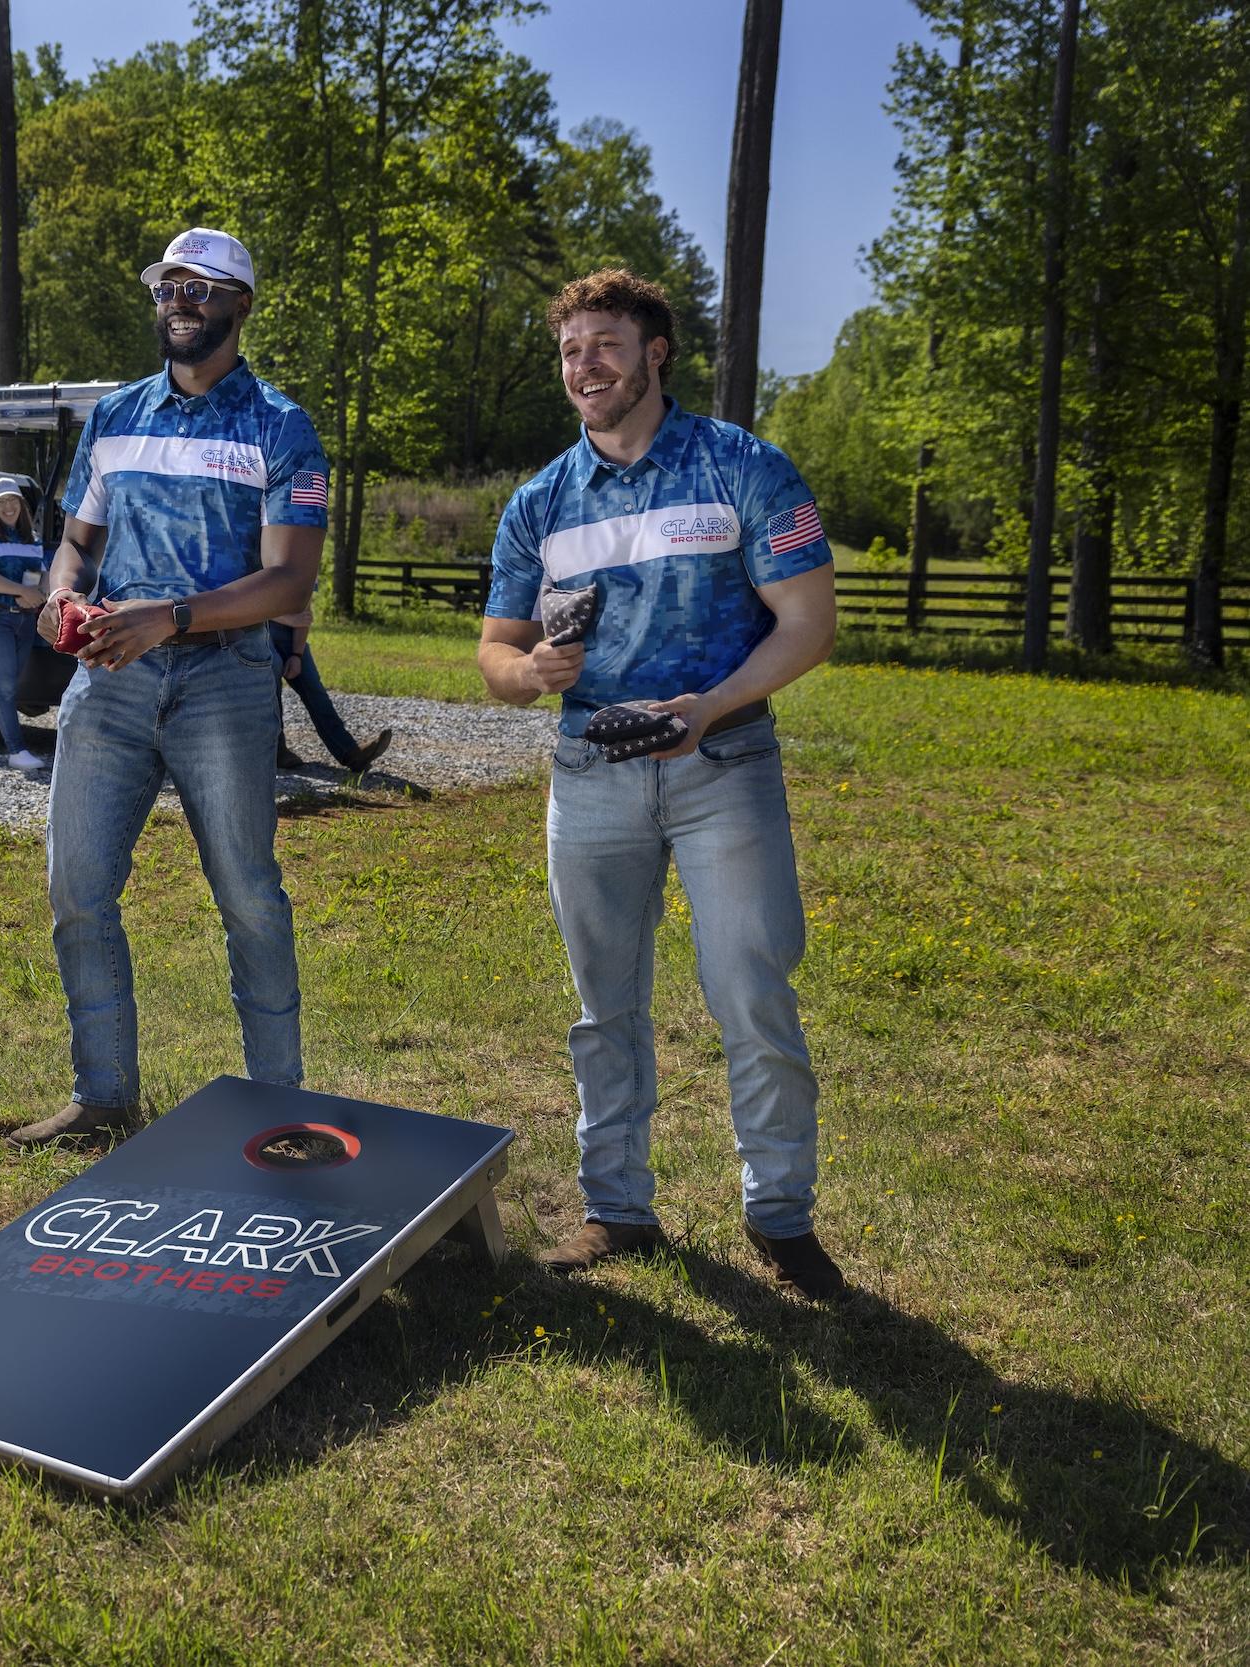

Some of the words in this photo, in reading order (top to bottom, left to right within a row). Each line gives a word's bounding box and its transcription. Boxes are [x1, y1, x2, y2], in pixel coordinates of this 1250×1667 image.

[201, 450, 261, 473] CLARK
[206, 462, 252, 476] BROTHERS
[661, 517, 735, 537] CLARK
[670, 535, 728, 544] BROTHERS
[24, 1198, 383, 1278] CLARK
[30, 1254, 291, 1298] BROTHERS
